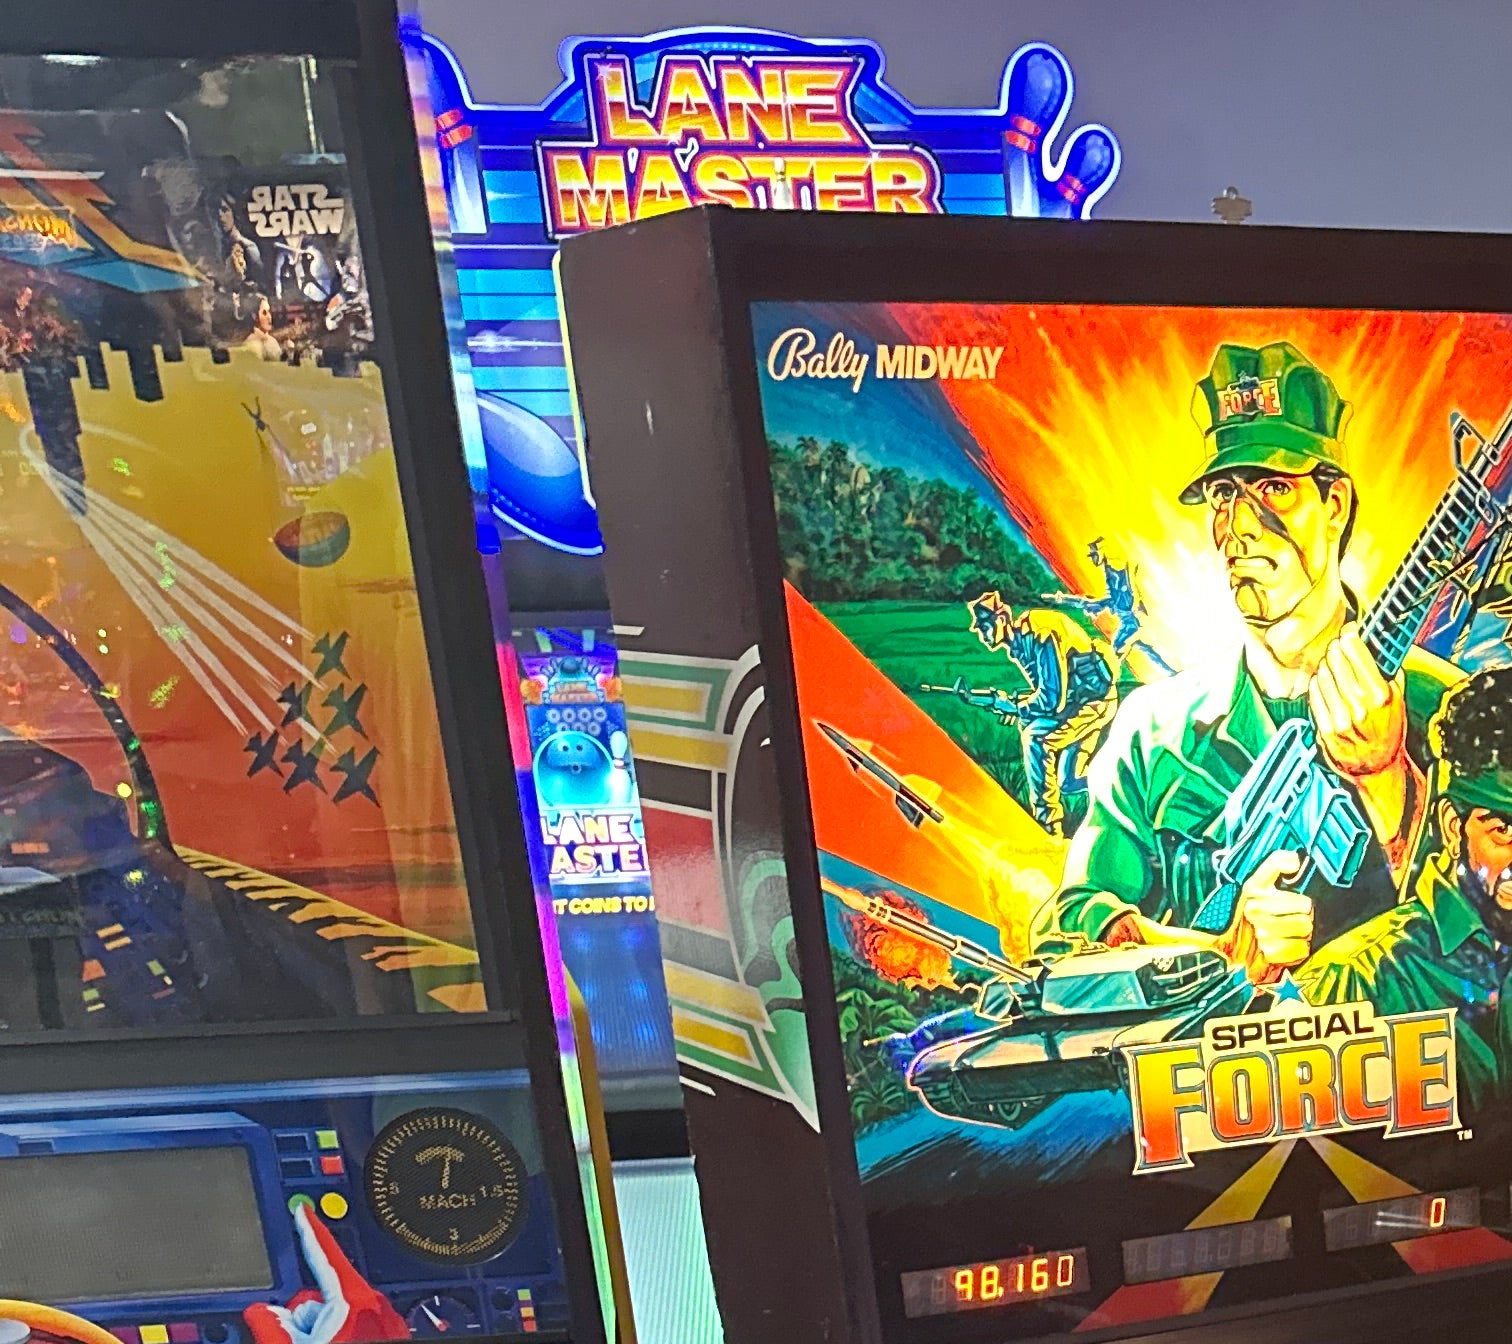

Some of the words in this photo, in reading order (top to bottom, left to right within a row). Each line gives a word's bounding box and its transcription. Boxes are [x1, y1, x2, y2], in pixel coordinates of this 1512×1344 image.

[599, 56, 862, 147] LANE
[550, 151, 940, 231] MASTER
[767, 327, 868, 393] Bally
[876, 344, 1004, 381] MIDWAY
[541, 815, 632, 845] LANE
[550, 845, 650, 875] ASTE
[568, 897, 622, 915] COINS
[623, 896, 650, 913] TO
[1212, 1010, 1375, 1051] SPECIAL
[1131, 1012, 1454, 1172] FORCE
